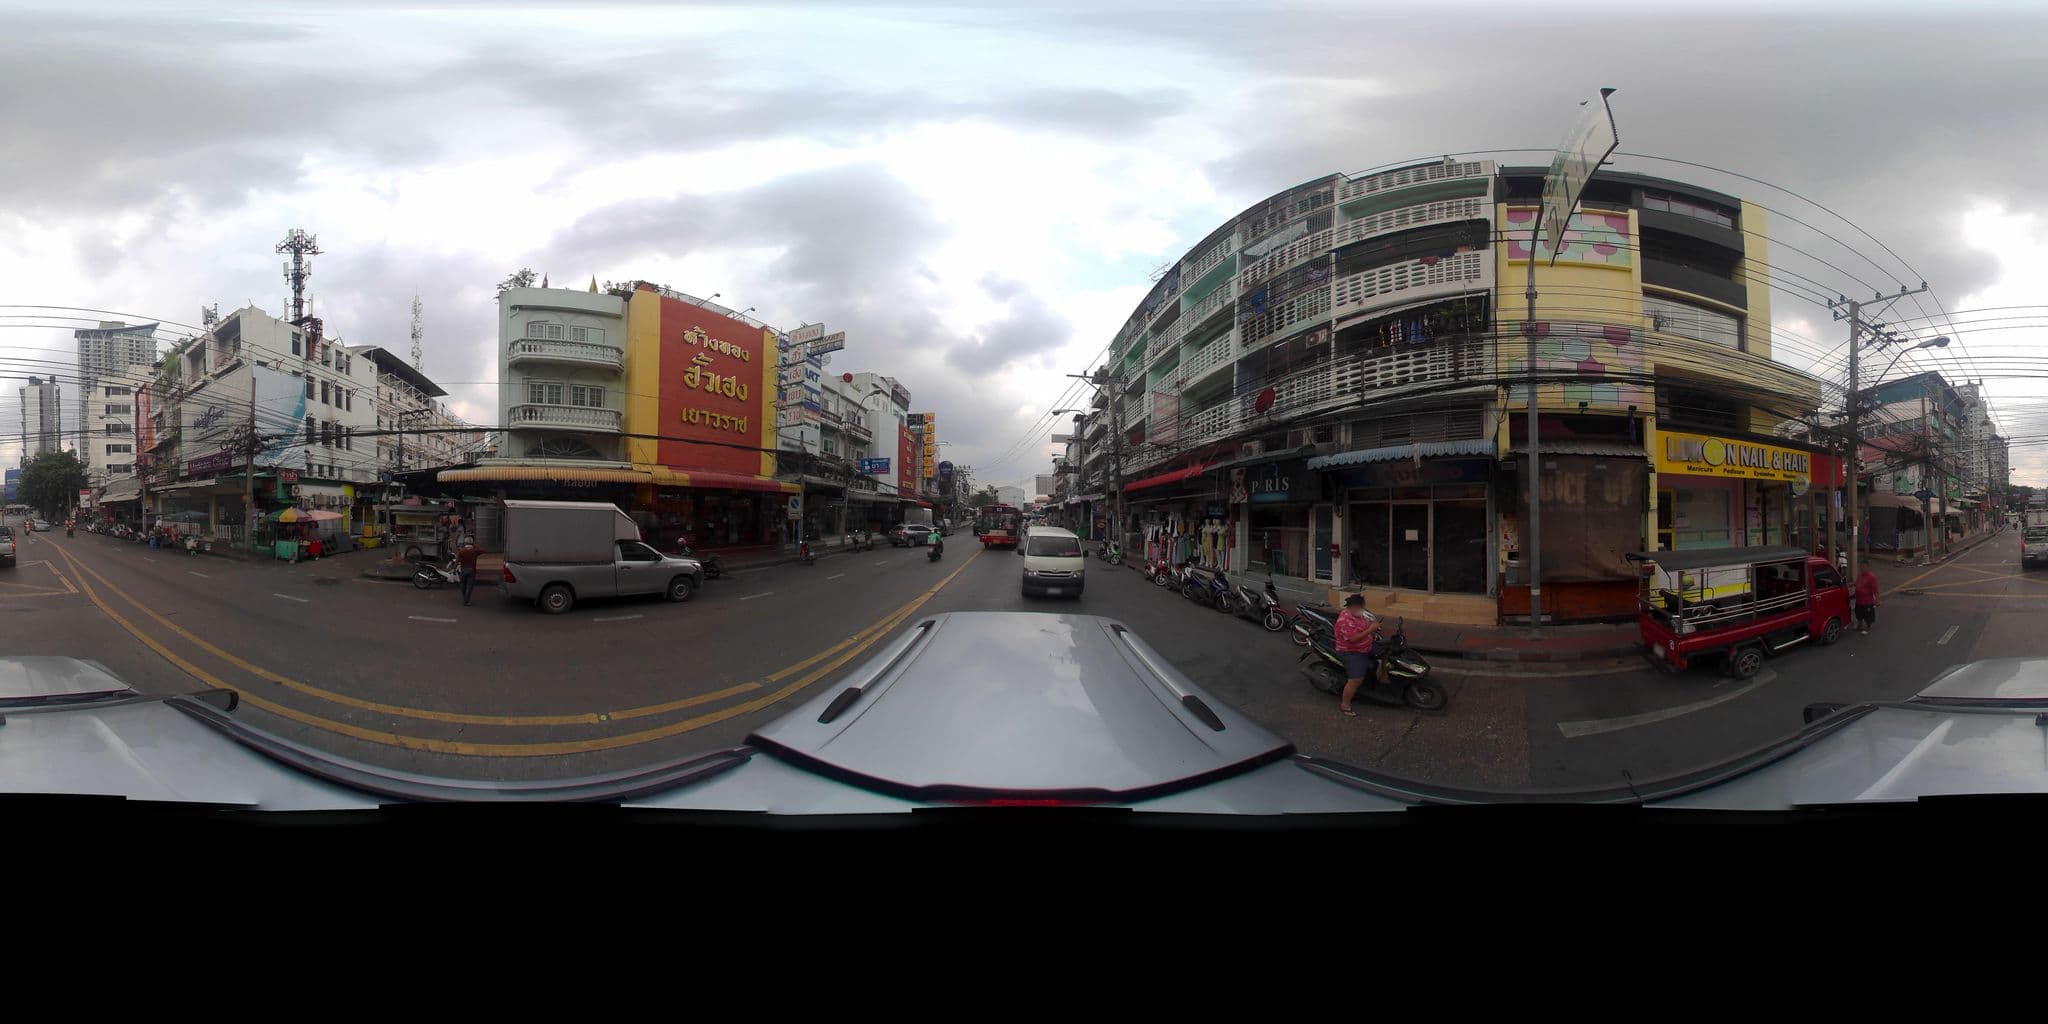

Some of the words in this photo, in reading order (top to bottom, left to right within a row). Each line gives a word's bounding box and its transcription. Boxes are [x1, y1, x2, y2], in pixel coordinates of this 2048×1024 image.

[683, 325, 750, 362] ห้างทอง
[681, 407, 748, 434] เยาวราช
[1740, 444, 1770, 468] NAIL
[1772, 449, 1781, 470] &
[1783, 452, 1808, 473] HAIR
[1252, 477, 1289, 493] PRIS
